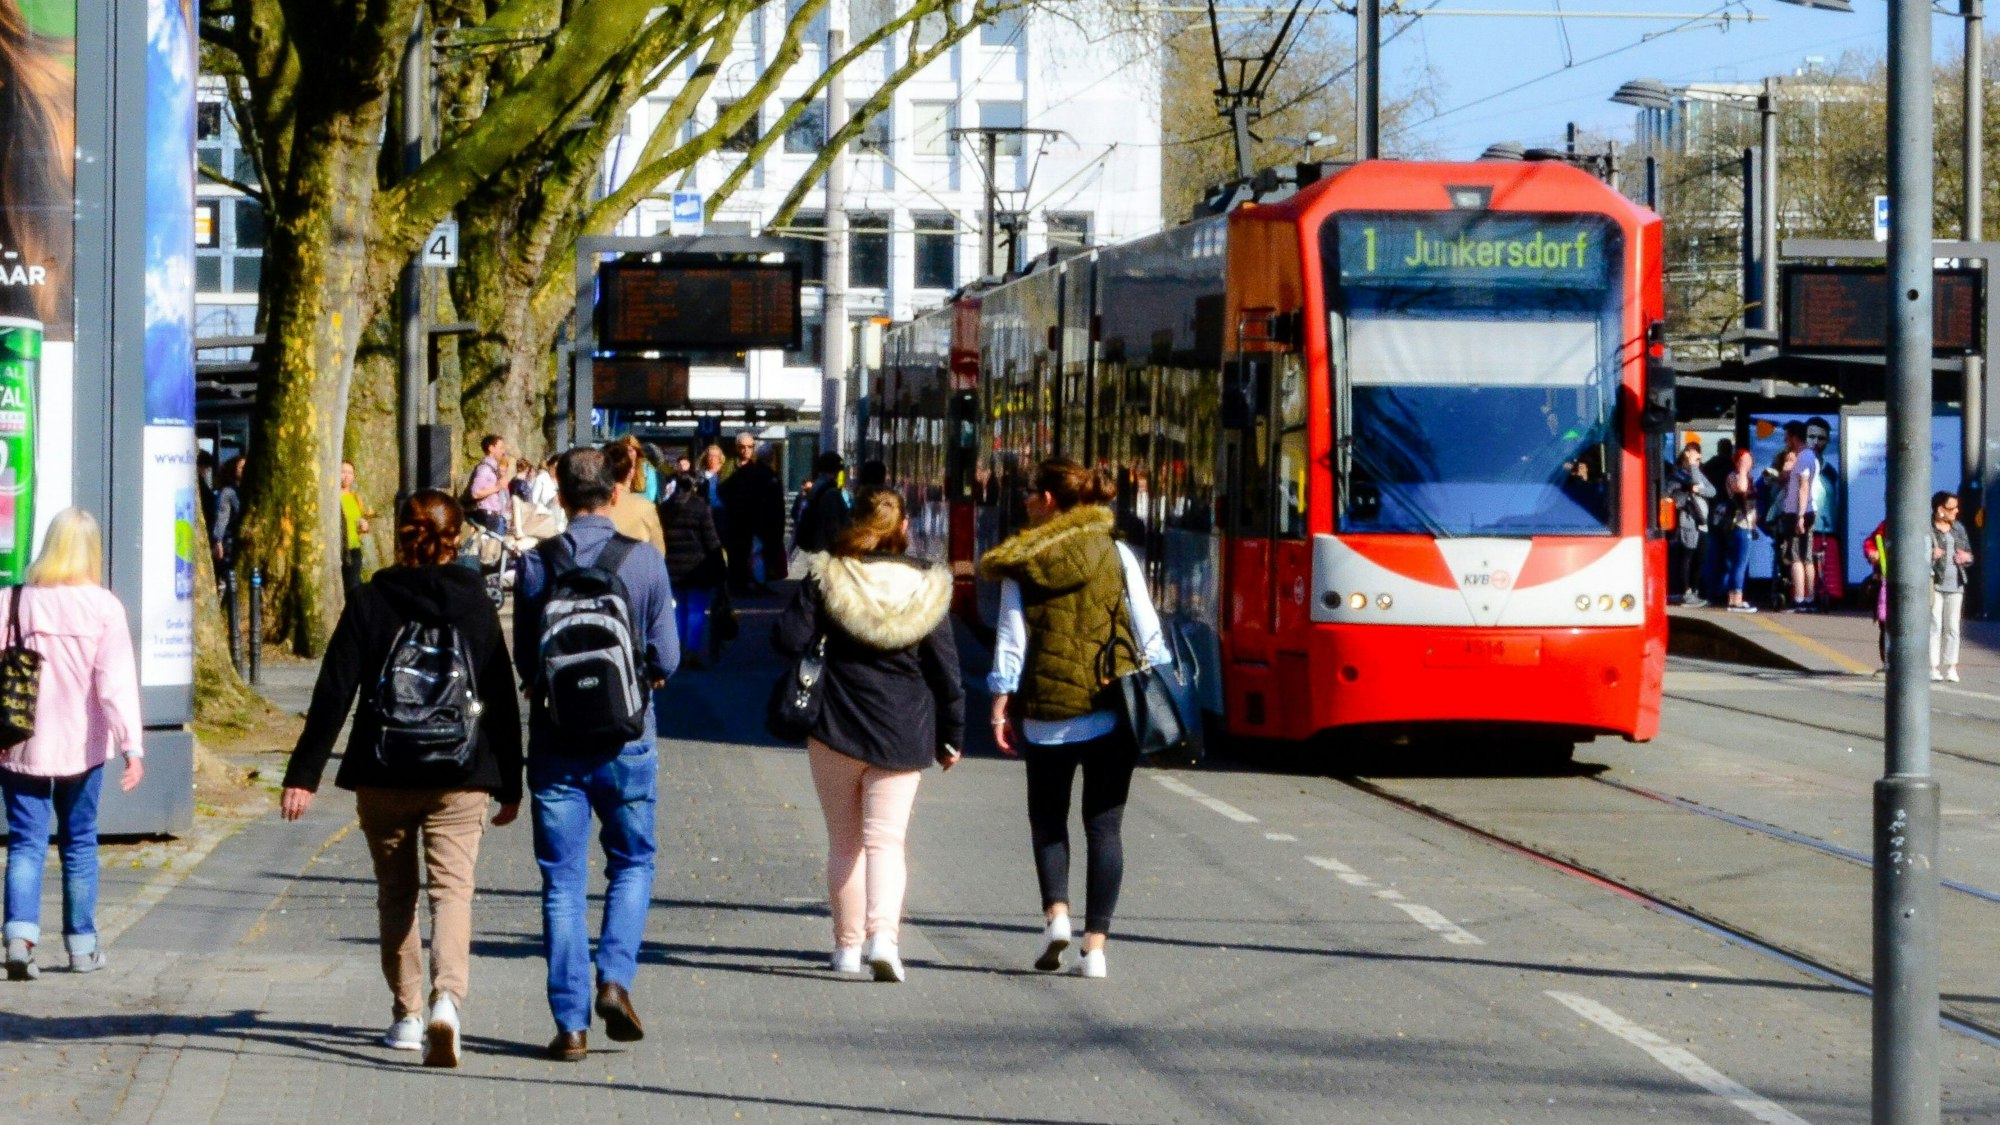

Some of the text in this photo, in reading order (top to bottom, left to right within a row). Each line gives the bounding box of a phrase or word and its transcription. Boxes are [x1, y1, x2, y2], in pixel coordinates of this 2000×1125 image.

[430, 235, 451, 260] 4
[1363, 227, 1589, 272] 1 Junkersdorf
[1464, 573, 1490, 585] KVB
